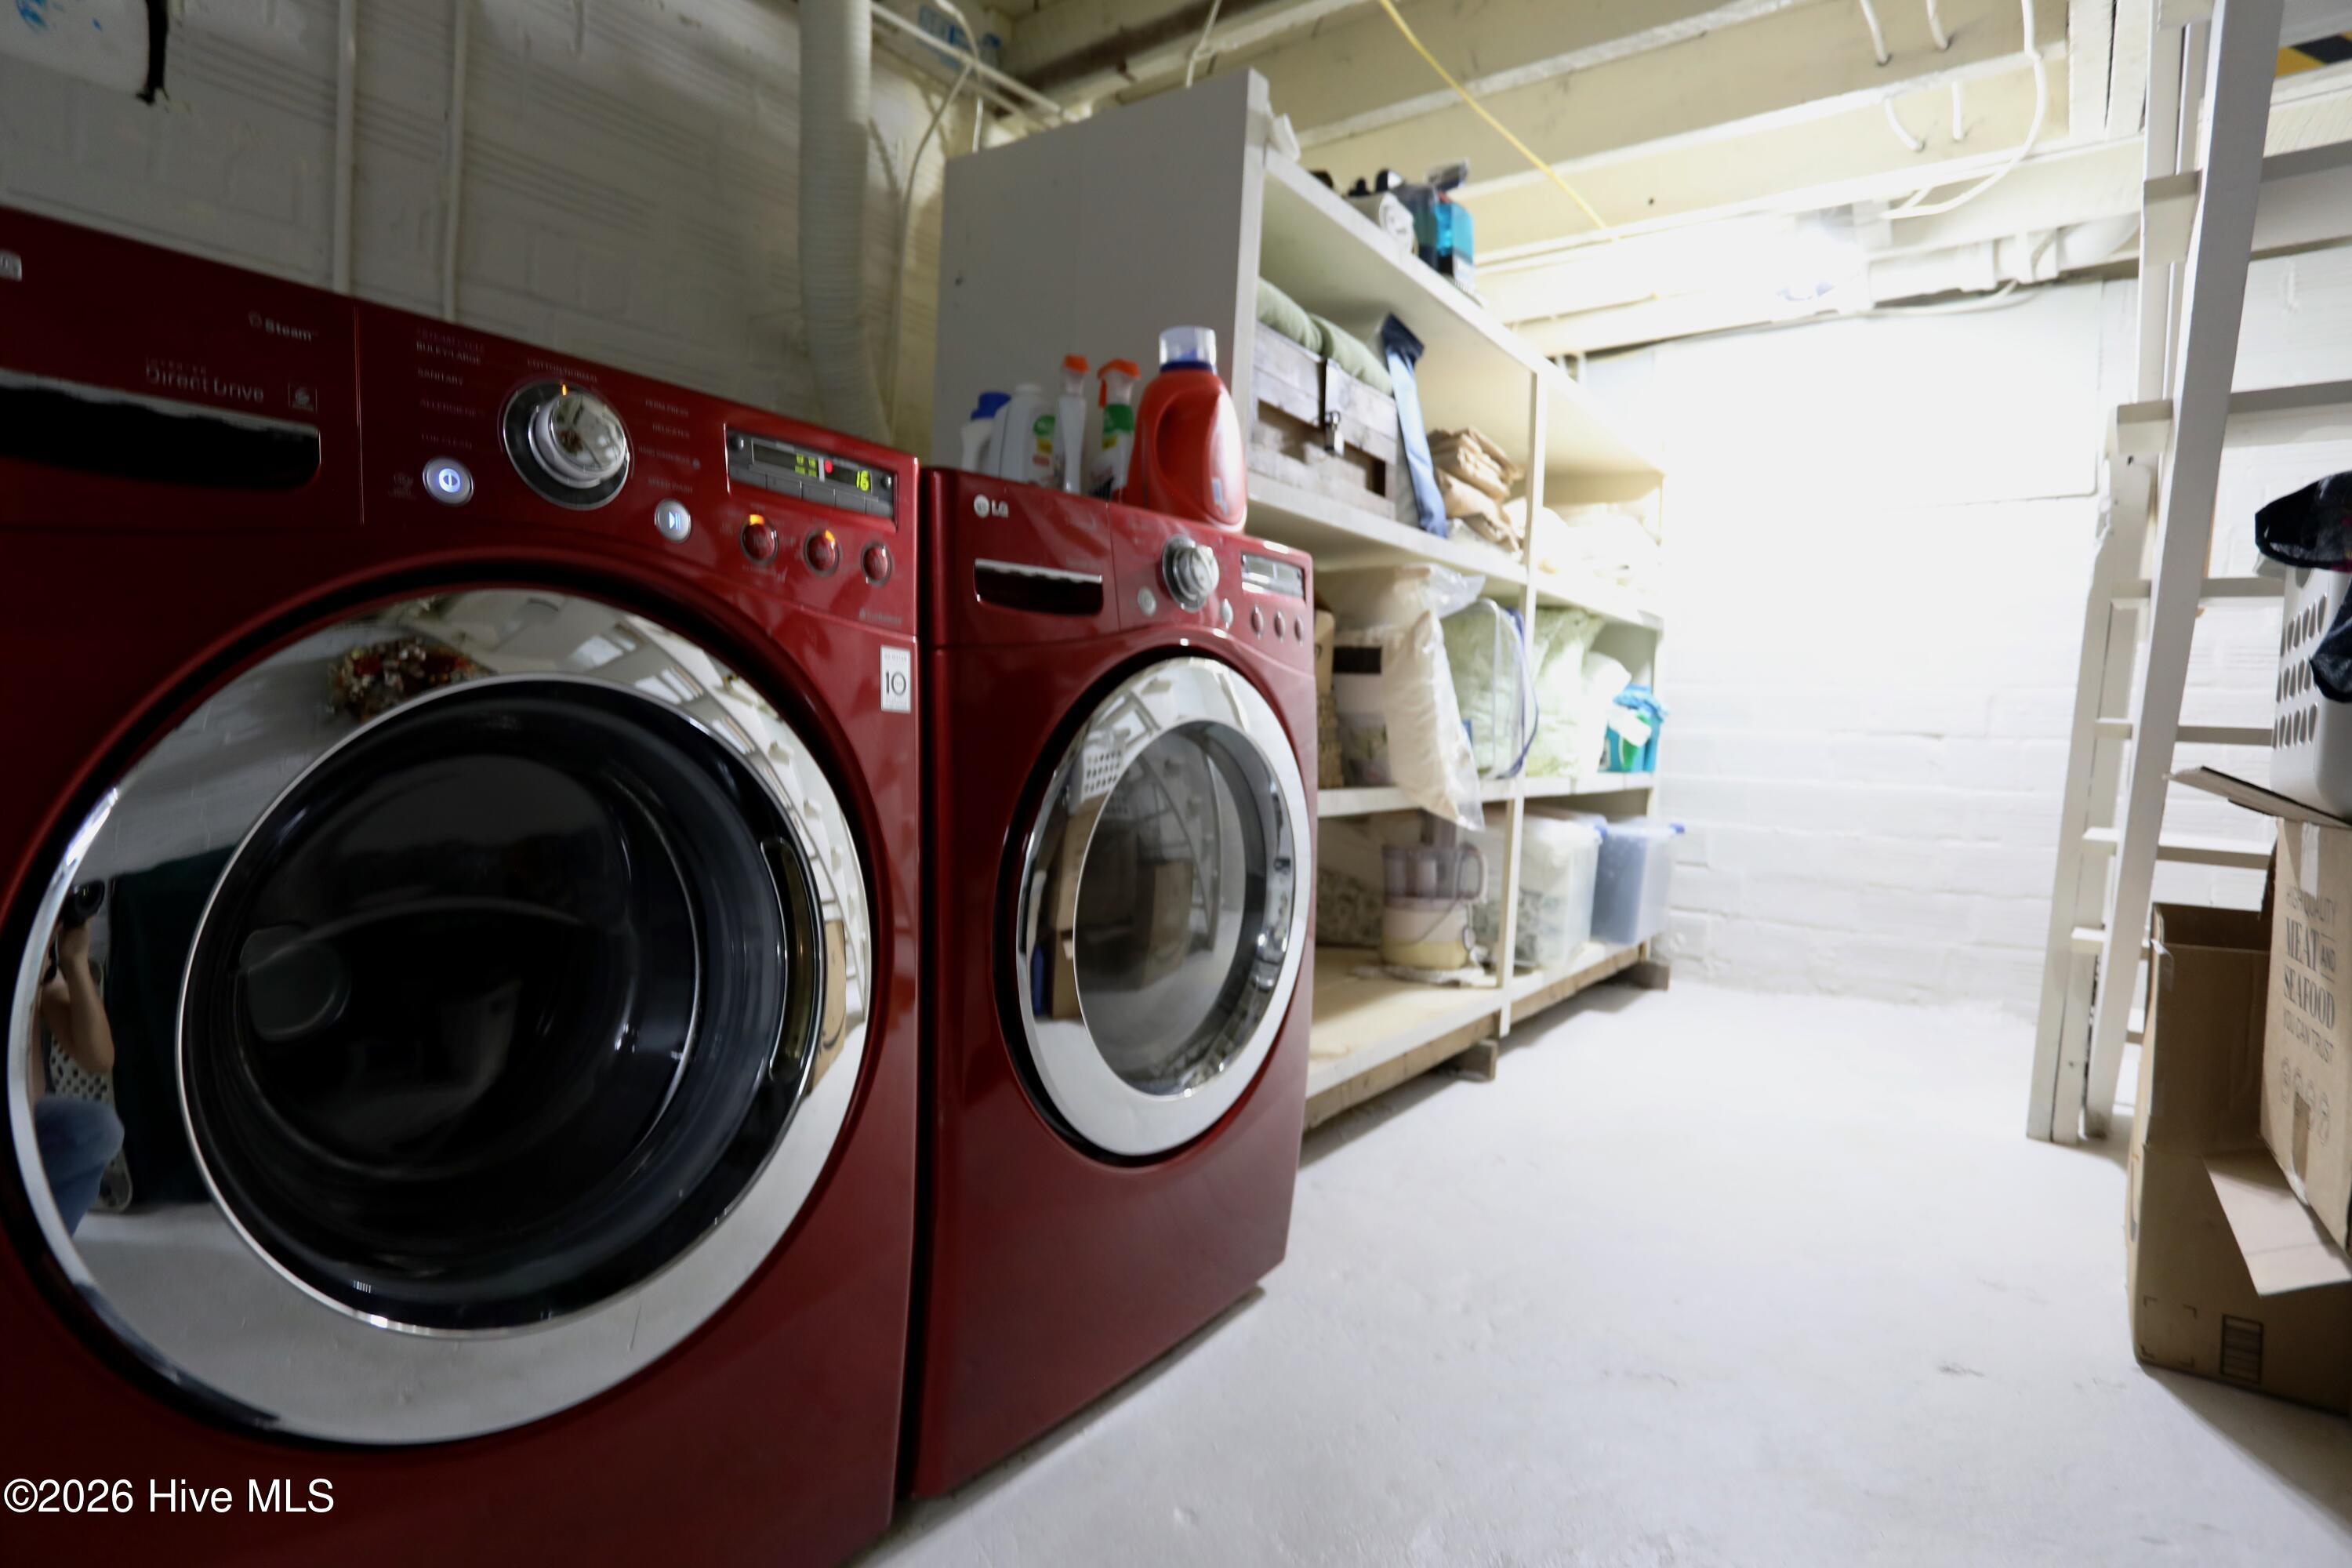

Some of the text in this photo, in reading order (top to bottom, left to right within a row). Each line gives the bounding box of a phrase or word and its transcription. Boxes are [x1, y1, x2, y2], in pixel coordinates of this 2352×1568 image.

[264, 317, 312, 342] Steam
[146, 364, 208, 395] Direct
[213, 377, 263, 403] Drive
[991, 499, 1009, 518] LG
[886, 670, 906, 696] 10
[2286, 916, 2320, 972] MEAT
[2321, 944, 2336, 973] AND
[2283, 964, 2335, 1030] SEAFOOD
[2296, 1016, 2310, 1047] CAN
[2311, 1028, 2334, 1063] TRUST
